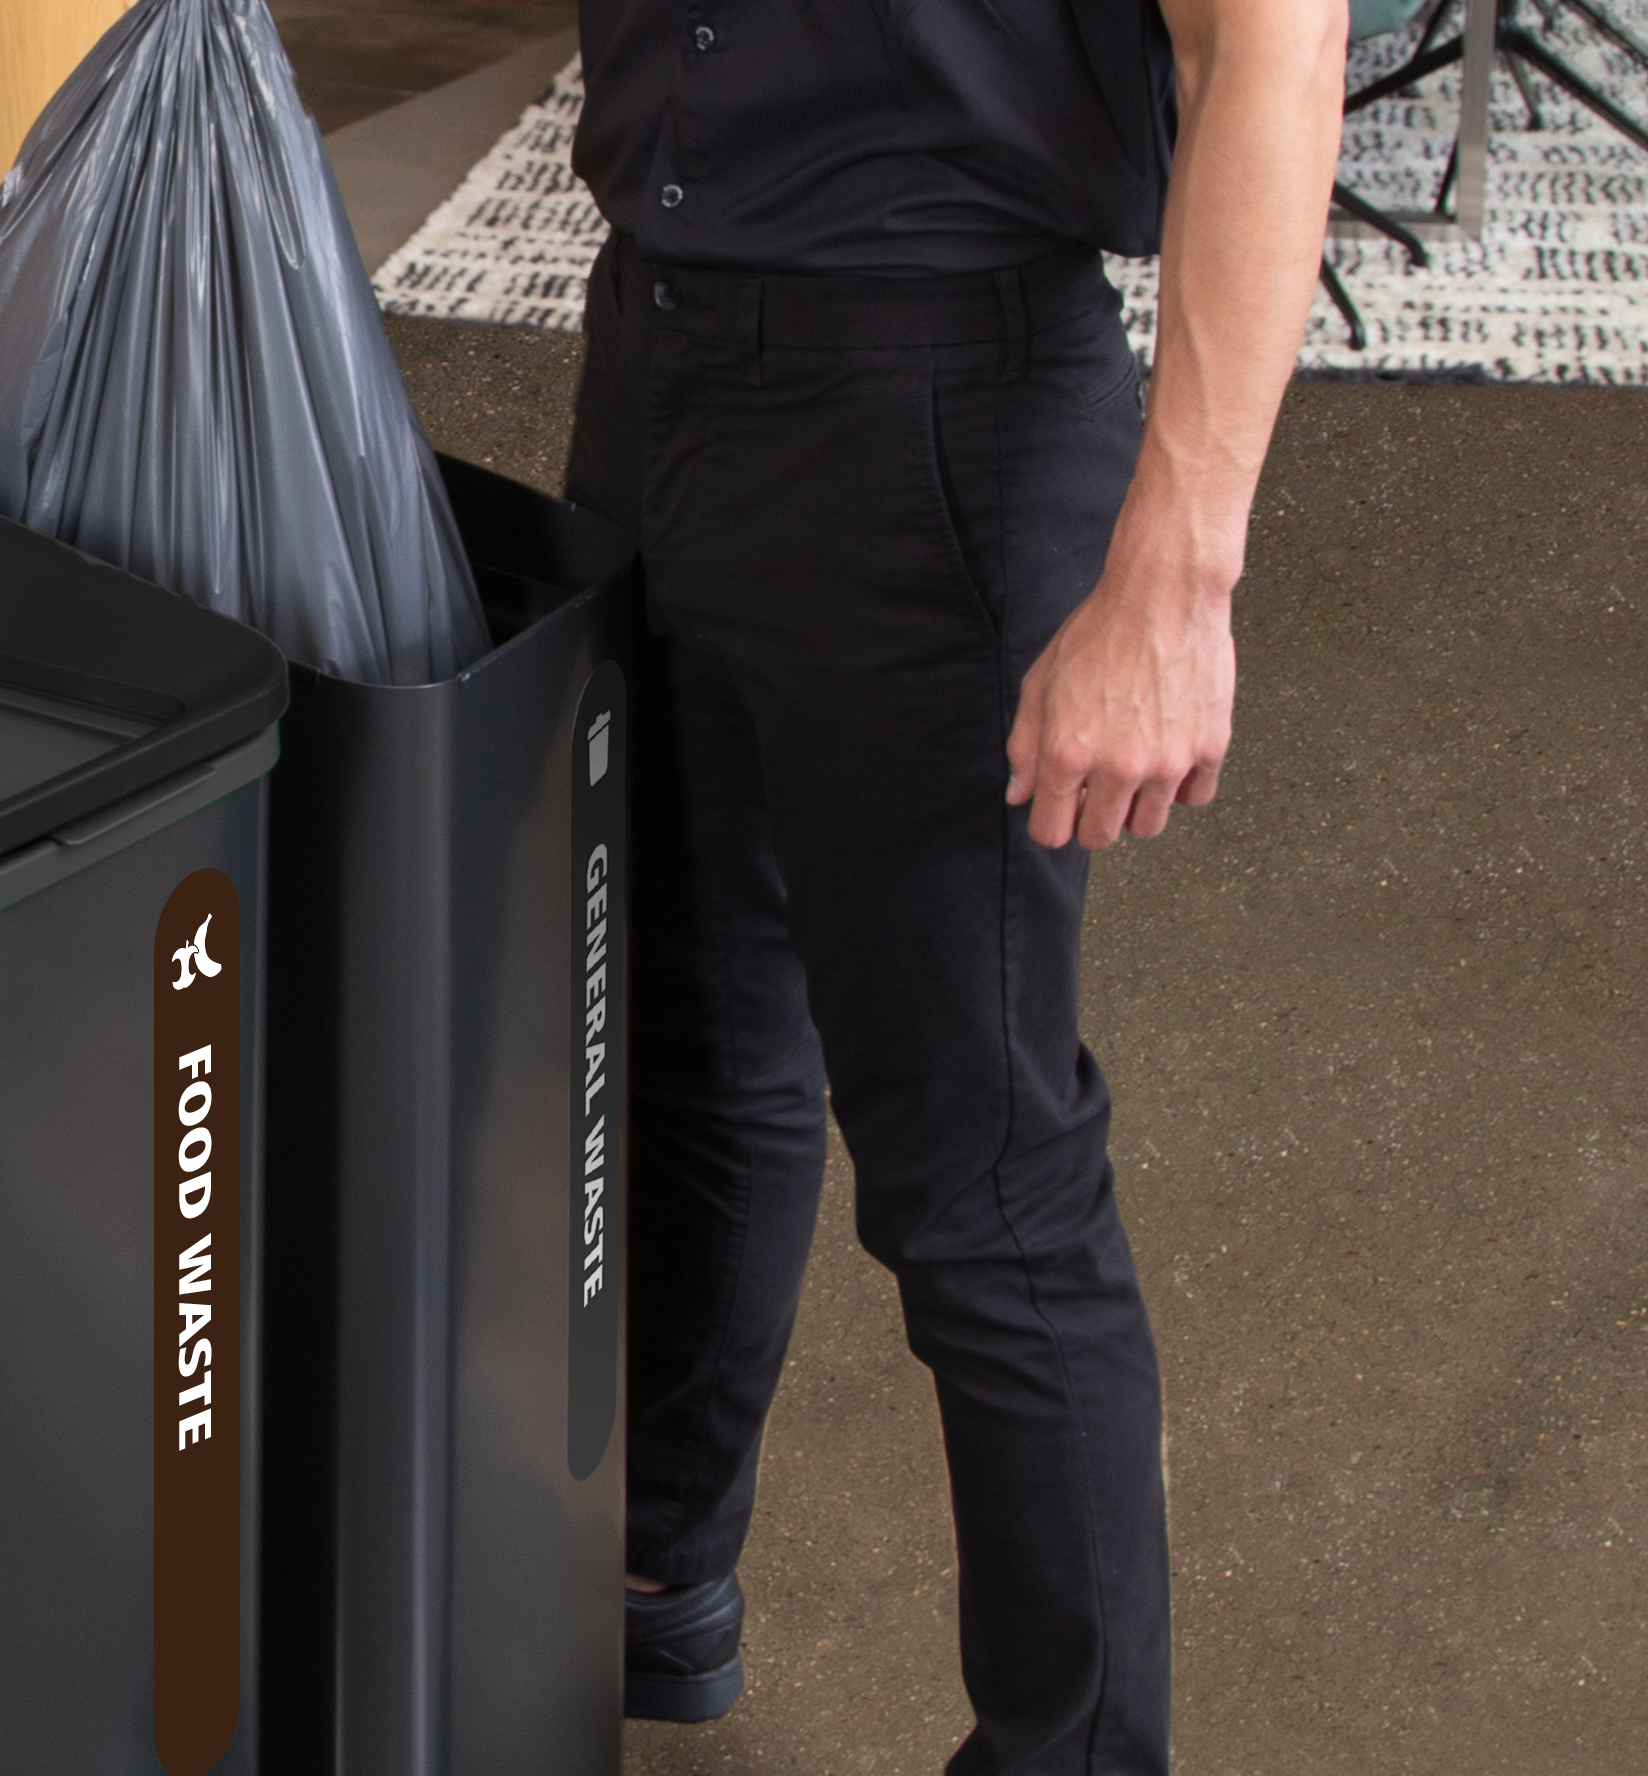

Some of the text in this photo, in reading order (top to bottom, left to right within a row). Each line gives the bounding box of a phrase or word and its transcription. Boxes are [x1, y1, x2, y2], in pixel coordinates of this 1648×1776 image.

[178, 1043, 212, 1452] FOOD WASTE
[583, 842, 608, 1308] GENERAL WASTE
